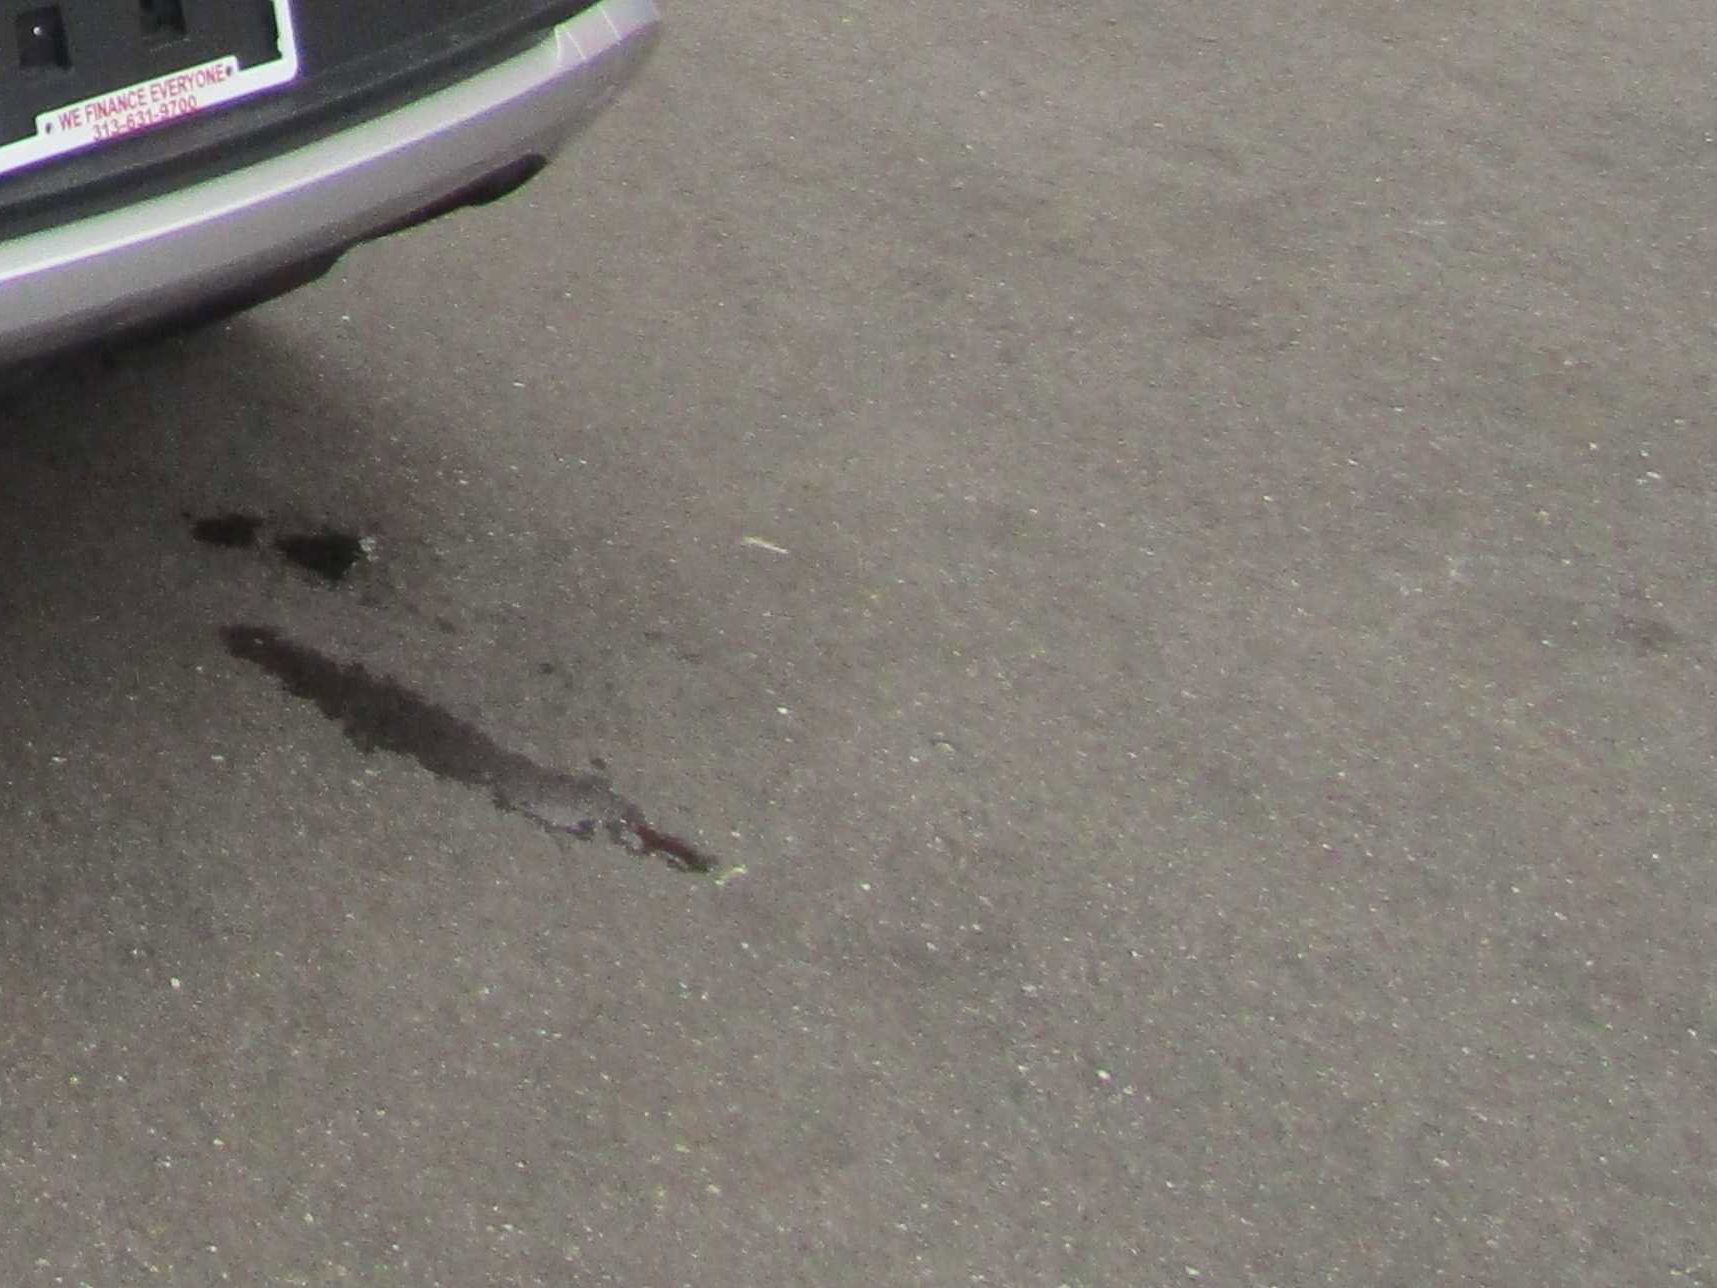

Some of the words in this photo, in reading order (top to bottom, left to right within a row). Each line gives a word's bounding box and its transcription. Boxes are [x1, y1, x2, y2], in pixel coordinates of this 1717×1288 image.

[58, 111, 81, 131] WE
[85, 88, 146, 121] FINANCE
[150, 63, 225, 103] EVERYONE
[93, 95, 198, 141] 313-631-9700
